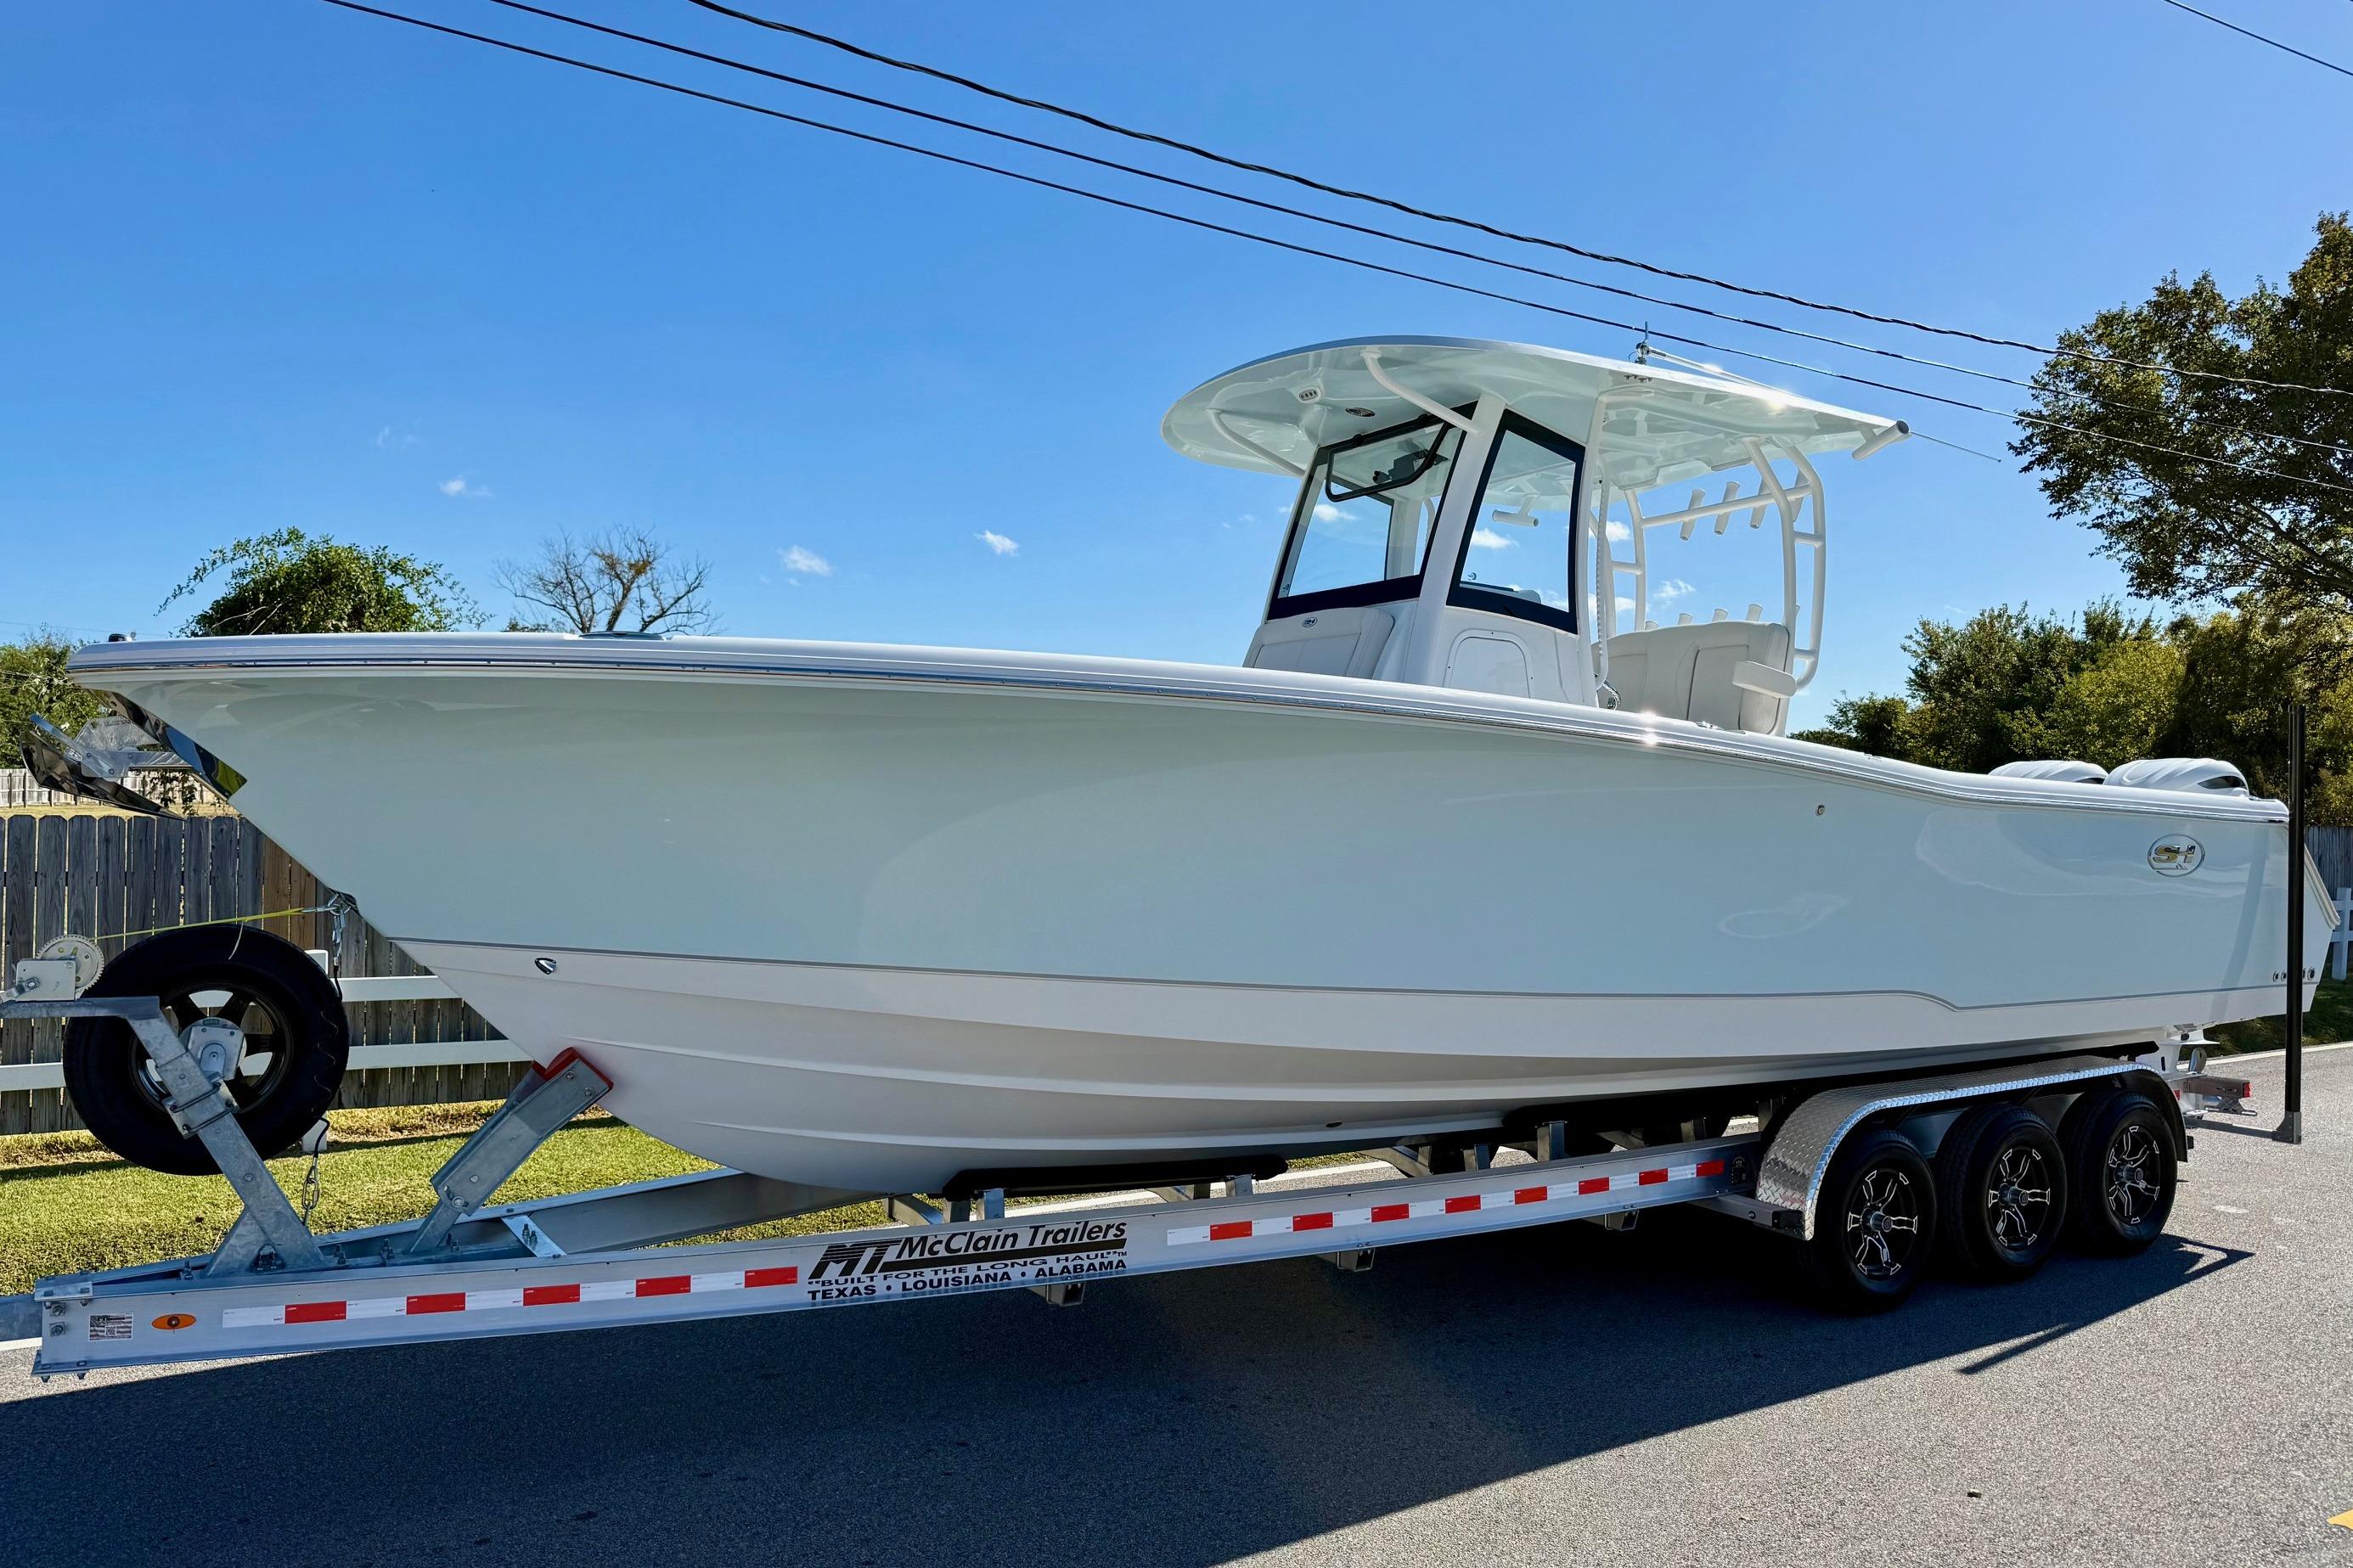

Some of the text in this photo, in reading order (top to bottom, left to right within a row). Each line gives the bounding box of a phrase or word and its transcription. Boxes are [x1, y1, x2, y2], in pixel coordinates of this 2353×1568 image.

[895, 1228, 1019, 1259] McClain
[1028, 1221, 1128, 1246] Trailers
[808, 1259, 1127, 1301] TEXAS LOUISIANA ALABAMA
[883, 1271, 925, 1281] FOR
[931, 1266, 968, 1276] THE
[977, 1259, 1048, 1272] LONG
